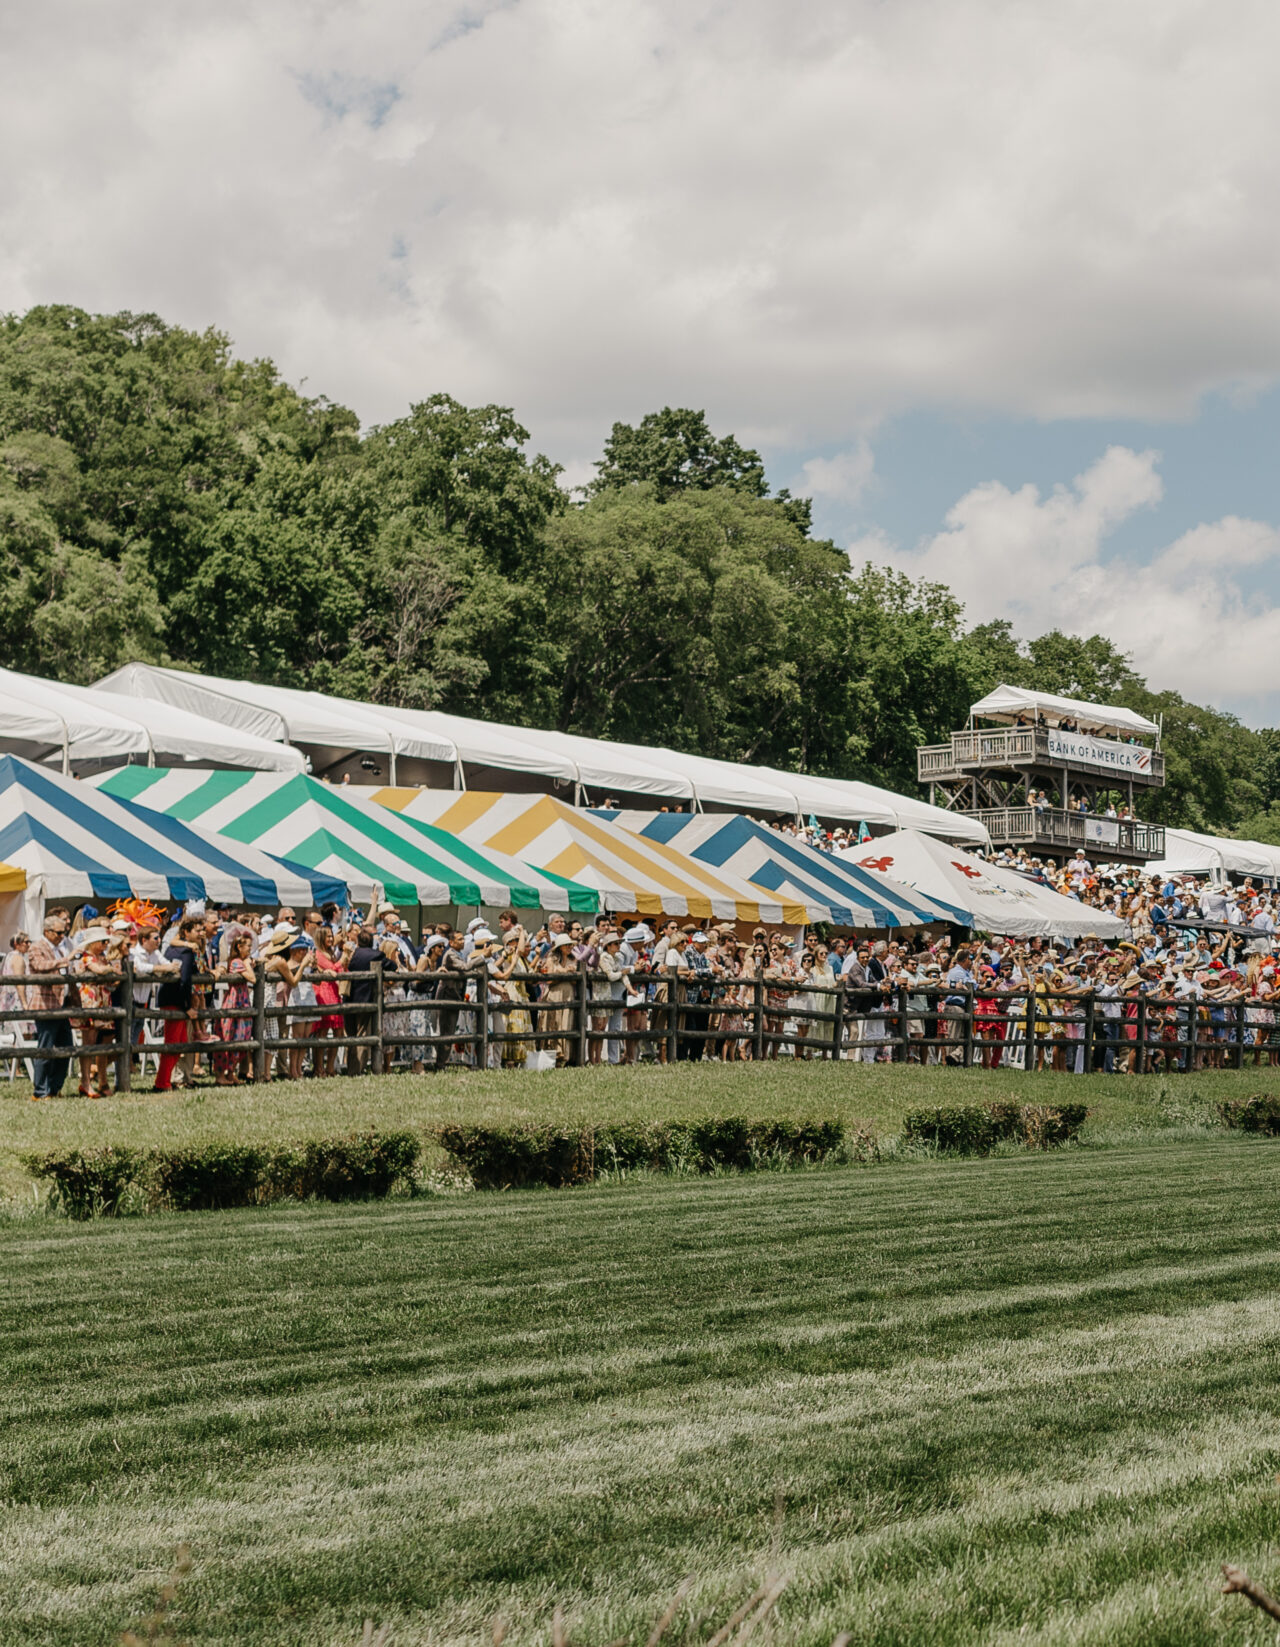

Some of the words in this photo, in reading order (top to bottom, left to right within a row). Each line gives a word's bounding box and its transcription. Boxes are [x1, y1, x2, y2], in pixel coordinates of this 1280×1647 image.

[1049, 741, 1076, 756] BANK
[1078, 746, 1089, 758] OF
[1091, 749, 1131, 766] AMERICA
